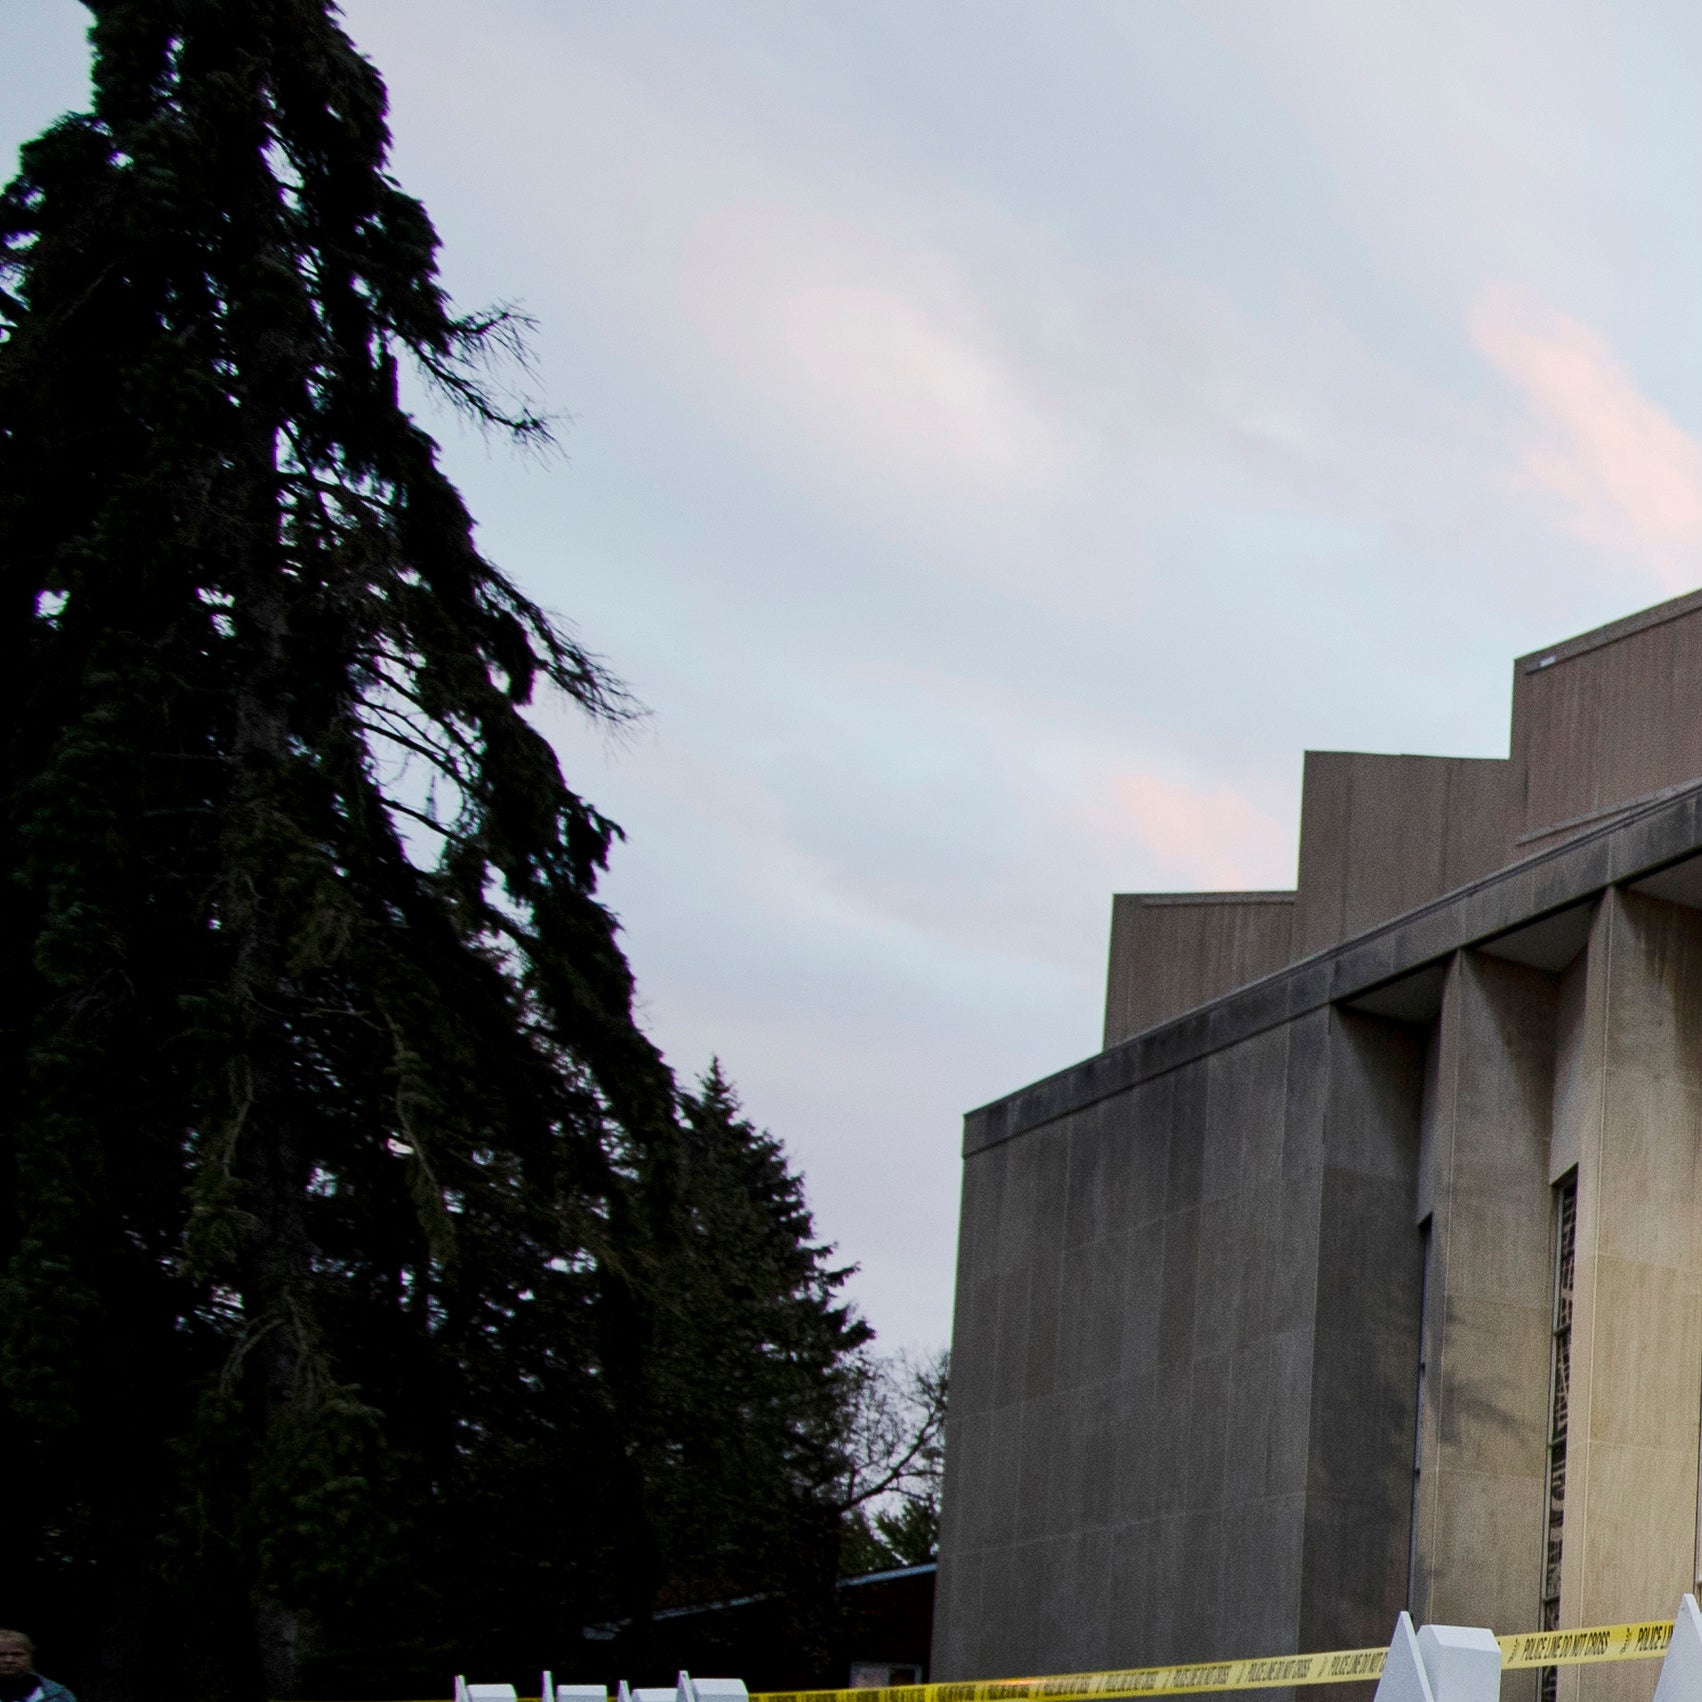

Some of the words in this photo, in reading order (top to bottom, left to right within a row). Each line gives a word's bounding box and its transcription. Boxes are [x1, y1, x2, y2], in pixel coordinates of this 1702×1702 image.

[1521, 1637, 1547, 1661] POLICE
[1559, 1634, 1572, 1658] DO
[1570, 1632, 1588, 1656] NOT
[1584, 1630, 1610, 1656] CROSS
[1634, 1625, 1663, 1652] POLICE
